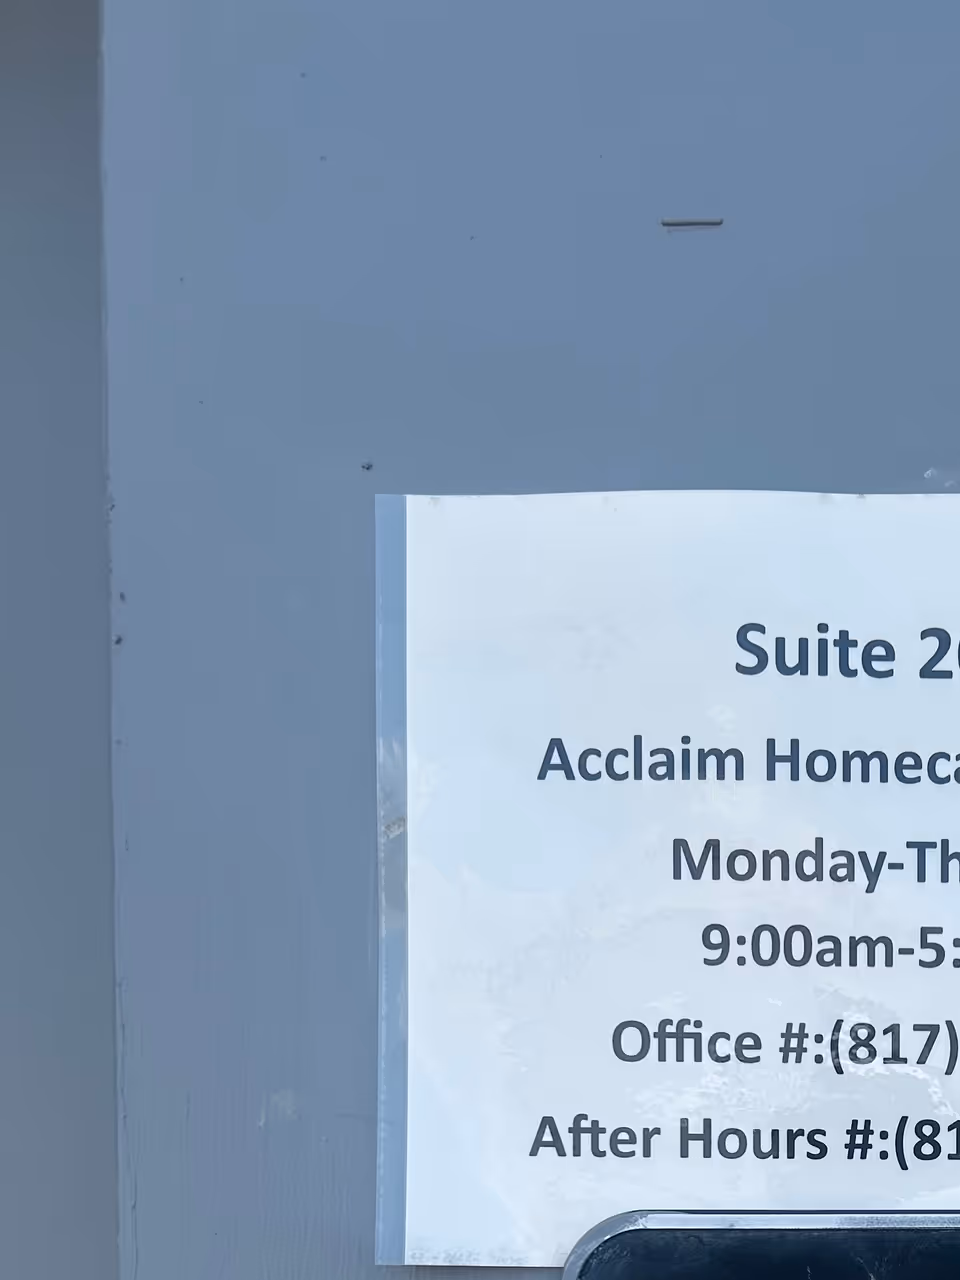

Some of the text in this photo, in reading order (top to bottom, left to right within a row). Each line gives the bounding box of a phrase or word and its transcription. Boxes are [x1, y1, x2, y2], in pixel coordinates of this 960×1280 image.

[735, 622, 896, 679] Suite
[536, 734, 745, 782] Acclaim
[611, 1018, 763, 1064] Office
[528, 1113, 662, 1159] After
[679, 1117, 829, 1161] Hours
